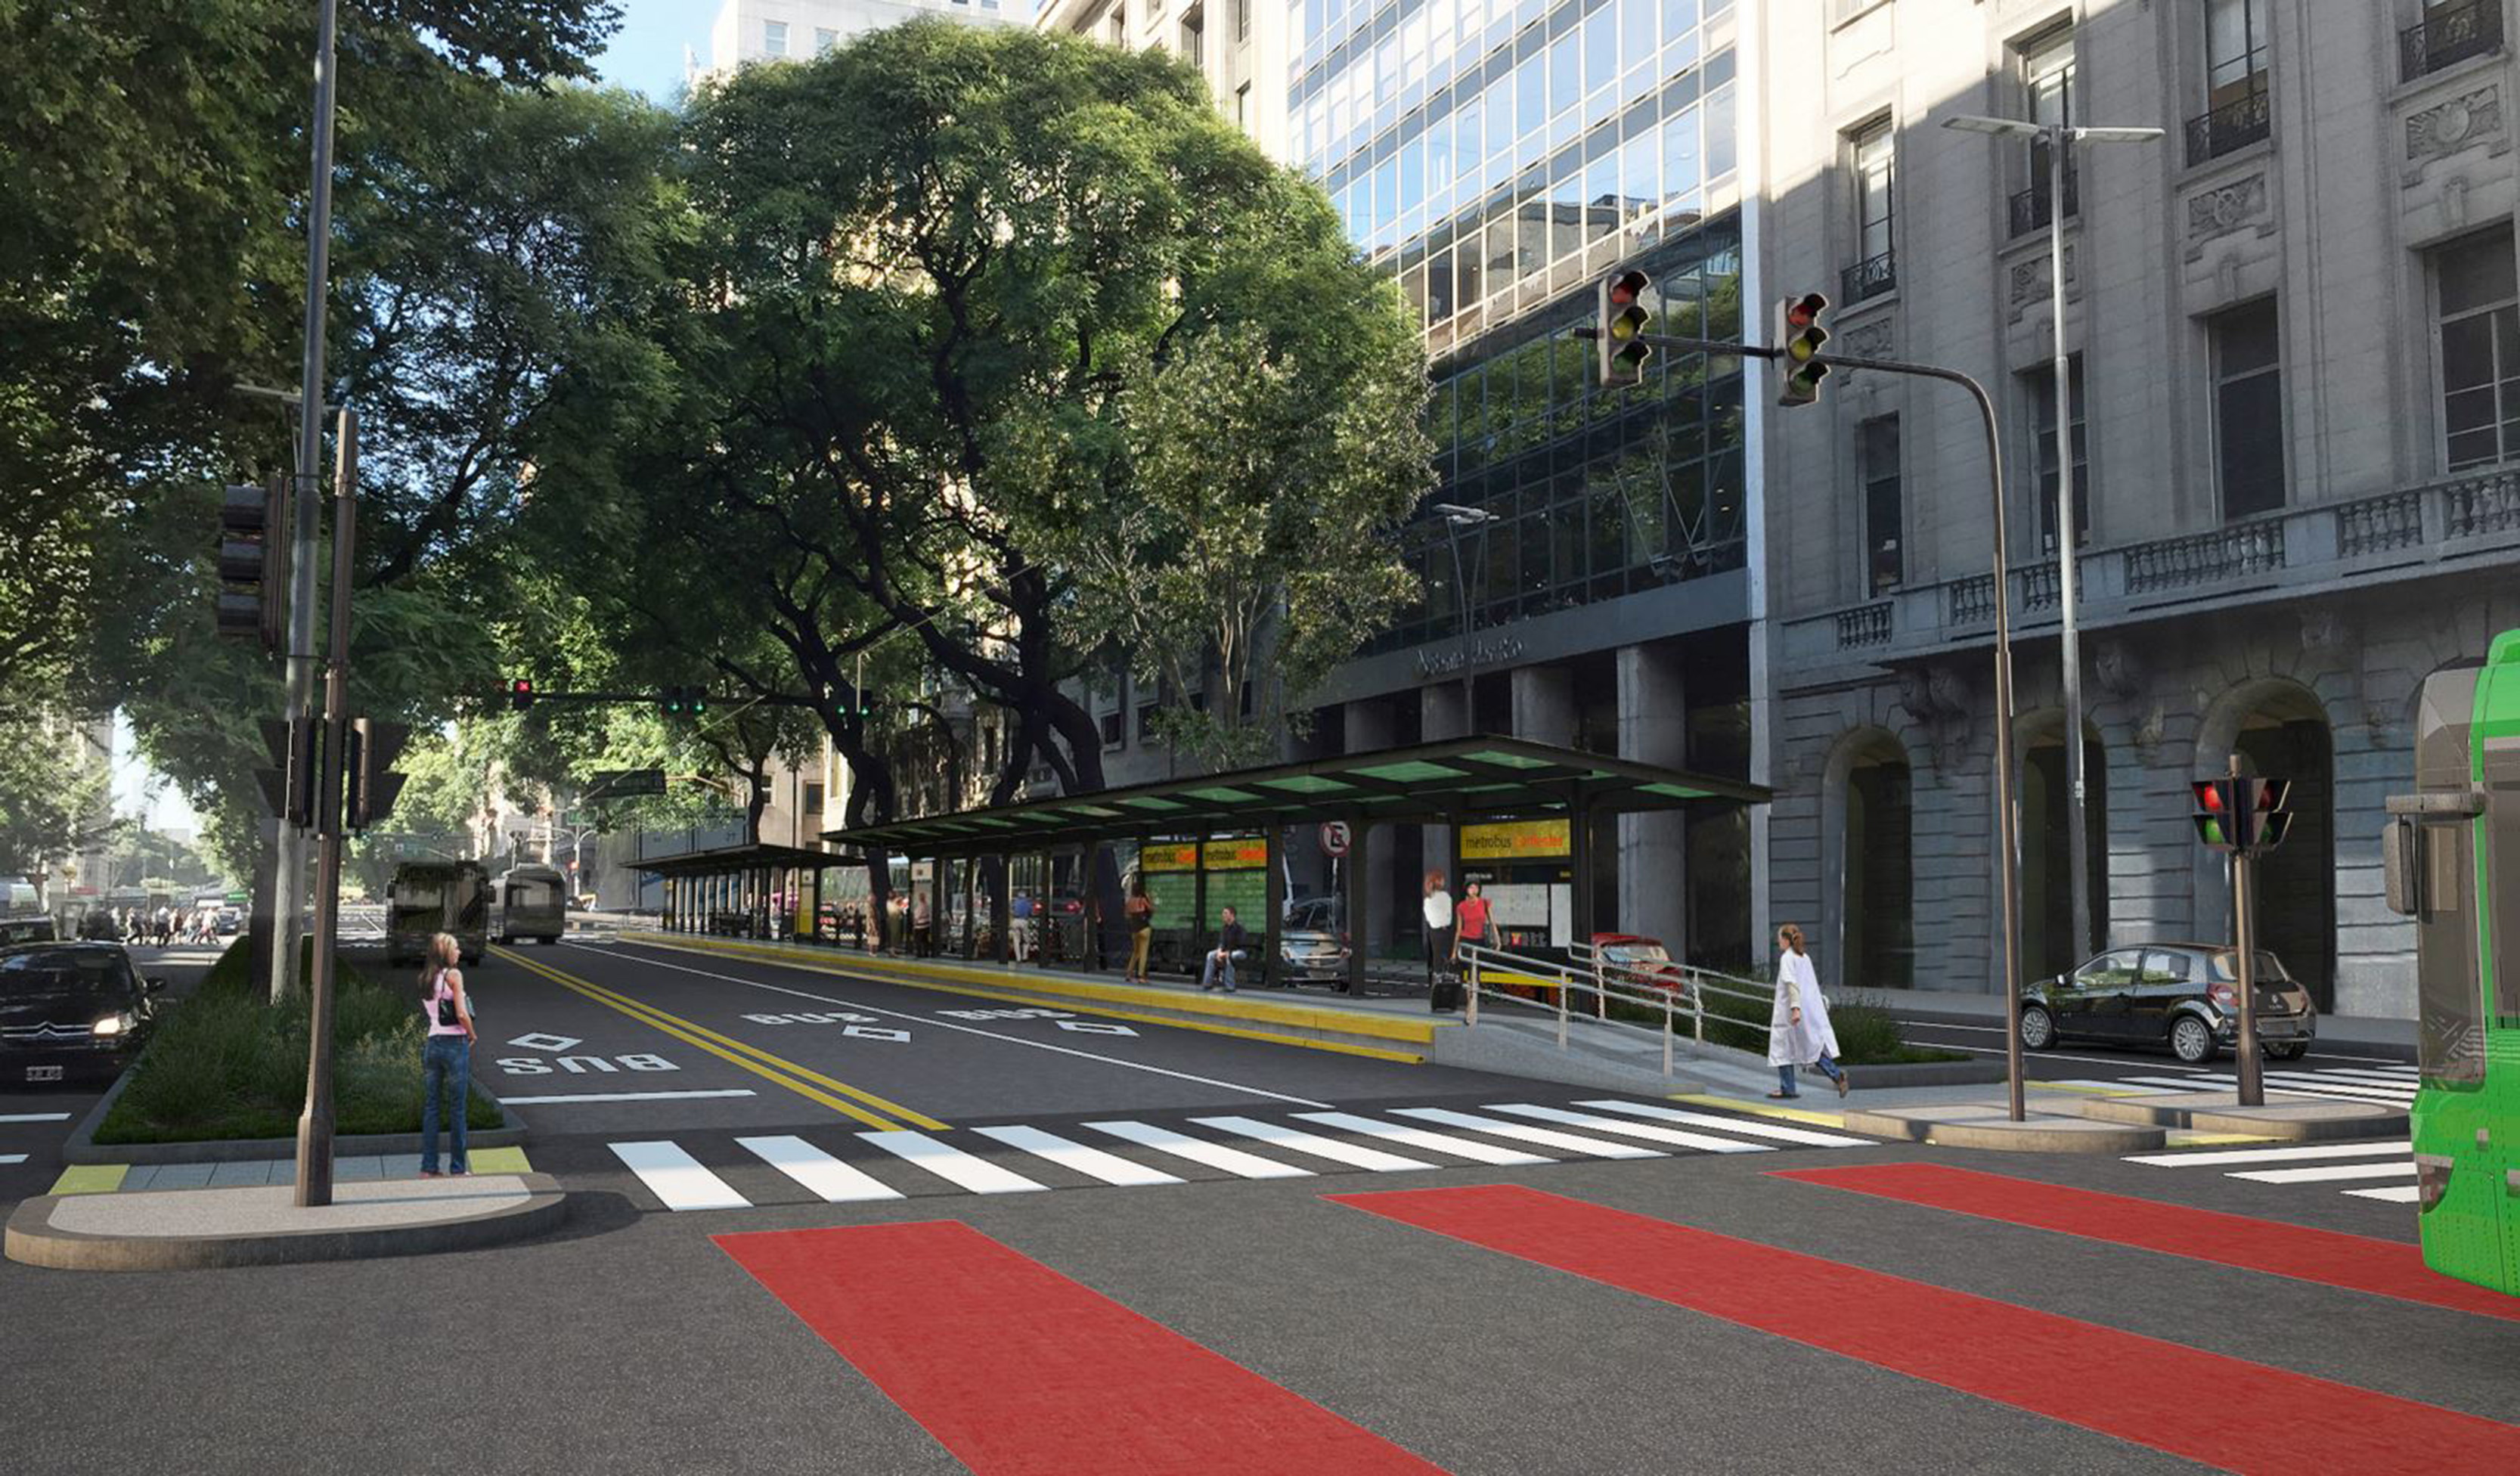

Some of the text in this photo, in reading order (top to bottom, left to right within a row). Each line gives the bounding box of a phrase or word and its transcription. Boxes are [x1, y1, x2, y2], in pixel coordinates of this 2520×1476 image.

[1331, 824, 1344, 847] E
[1465, 834, 1512, 849] metrobus
[739, 1012, 880, 1025] BUS
[495, 1053, 681, 1074] BUS
